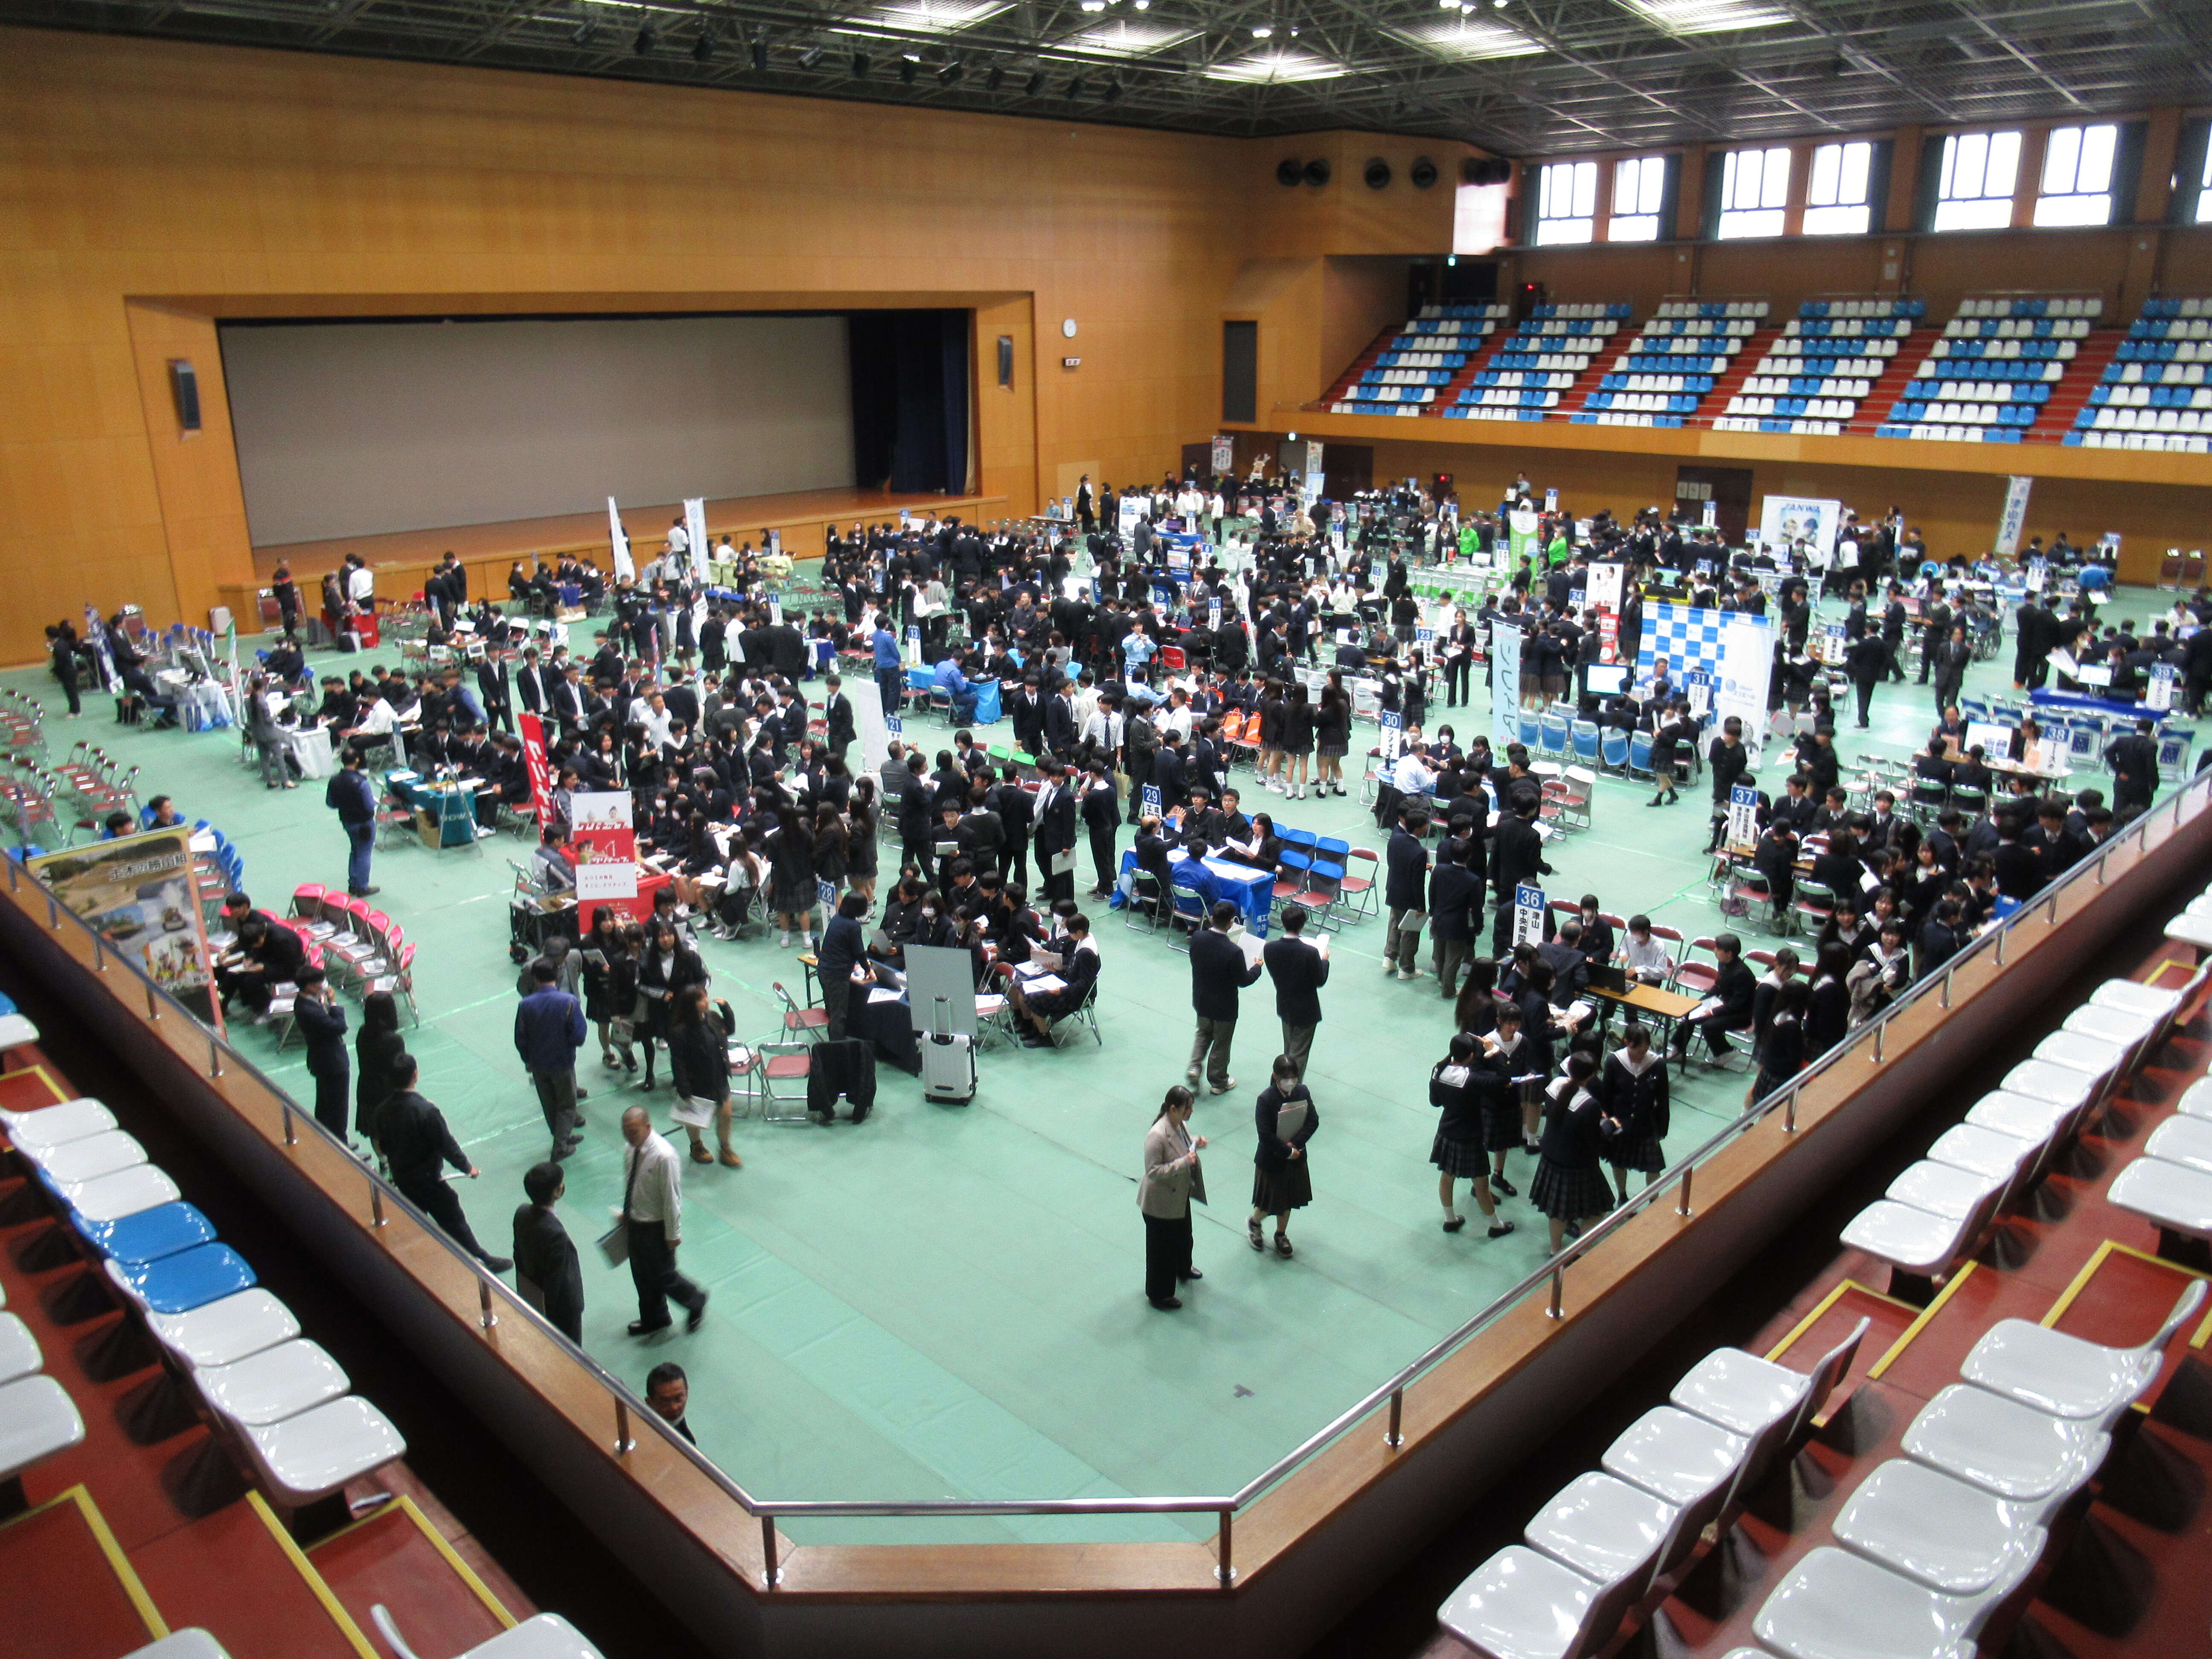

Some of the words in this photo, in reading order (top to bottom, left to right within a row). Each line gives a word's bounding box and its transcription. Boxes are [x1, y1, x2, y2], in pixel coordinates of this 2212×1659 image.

[1572, 593, 1583, 601] 24
[1212, 600, 1220, 608] 14
[911, 629, 918, 639] 13
[1420, 630, 1430, 640] 23
[1829, 626, 1842, 637] 32
[1693, 673, 1705, 685] 31
[890, 719, 899, 731] 21
[1385, 714, 1398, 727] 30
[2049, 727, 2065, 741] 38
[1146, 789, 1158, 803] 29
[1735, 789, 1753, 804] 37
[821, 885, 832, 902] 28
[1520, 889, 1540, 908] 36
[1518, 908, 1528, 943] 中央病院
[1532, 911, 1540, 929] 津山
